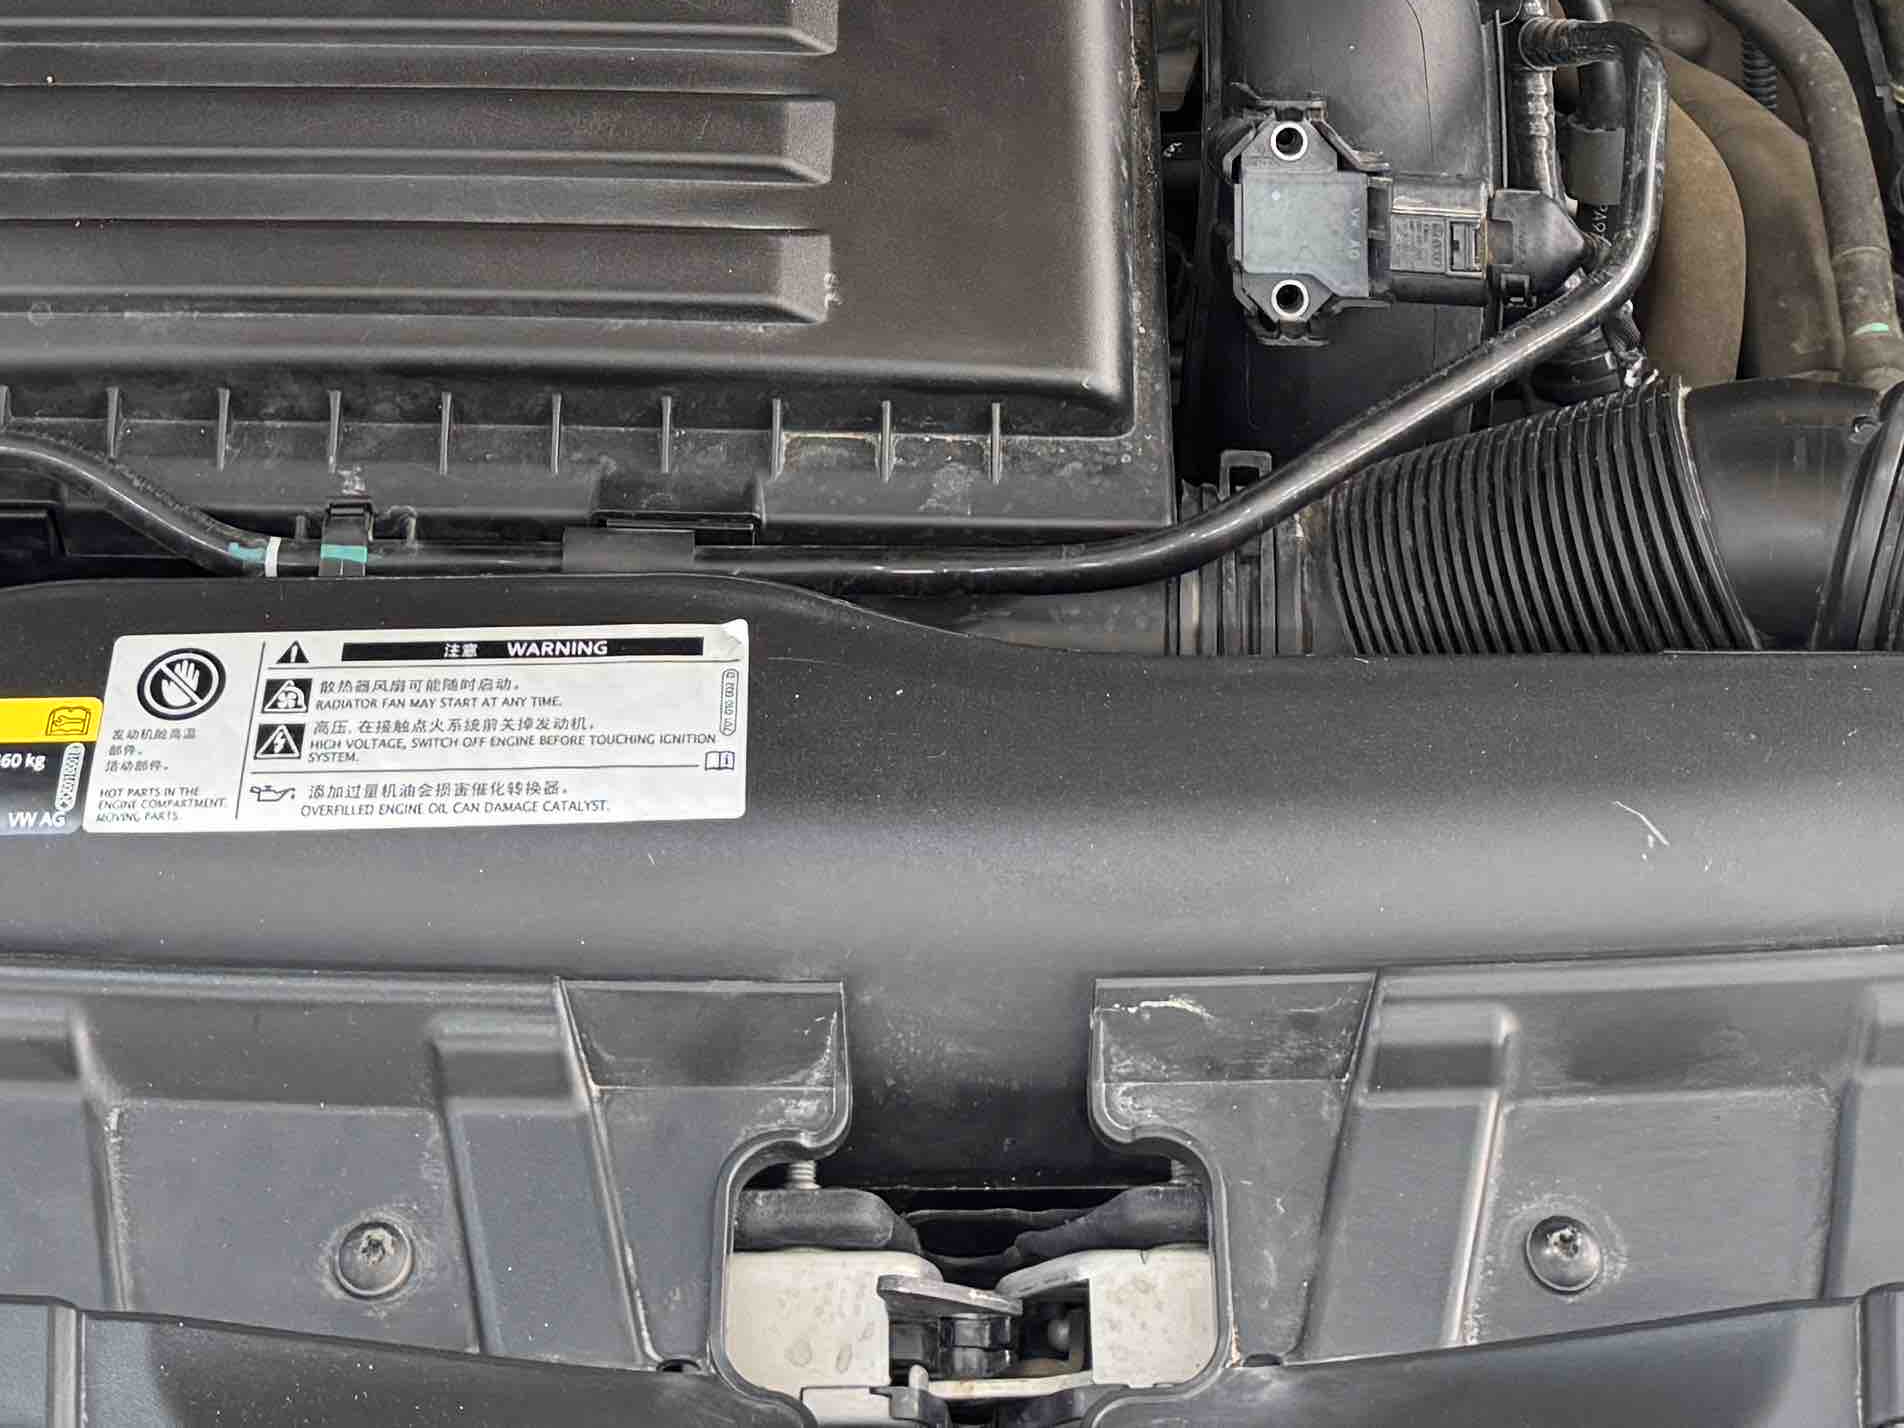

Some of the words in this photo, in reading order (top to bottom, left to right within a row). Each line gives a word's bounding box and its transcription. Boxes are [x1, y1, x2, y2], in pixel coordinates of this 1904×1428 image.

[444, 643, 478, 658] 注意
[507, 640, 608, 657] WARNING
[319, 677, 519, 694] 散热器风扇可能随时启动。
[315, 699, 377, 710] RADIATOR
[382, 698, 406, 709] FAN
[410, 698, 436, 709] MAY
[440, 698, 477, 709] START
[481, 698, 497, 707] AT
[502, 697, 527, 707] ANY
[531, 696, 562, 707] TIME.
[310, 738, 341, 750] HIGH
[346, 737, 407, 750] VOLTAGE,
[411, 737, 458, 749] SWITCH
[463, 736, 487, 748] OFF
[490, 735, 535, 747] ENGINE
[539, 735, 585, 746] BEFORE
[590, 734, 655, 745] TOUCHING
[659, 733, 716, 745] IGNITION
[25, 753, 47, 772] kg
[308, 752, 359, 764] SYSTEM.
[100, 787, 122, 798] HOT
[127, 787, 160, 797] PARTS
[164, 787, 175, 797] IN
[180, 786, 199, 796] THE
[98, 799, 136, 809] ENGINE
[301, 803, 374, 816] OVERFILLED
[379, 803, 425, 816] ENGINE
[428, 802, 449, 815] OIL
[453, 802, 480, 814] CAN
[485, 801, 538, 813] DAMAGE
[543, 799, 610, 812] CATALYST.
[8, 812, 38, 829] VW
[42, 812, 66, 828] AG
